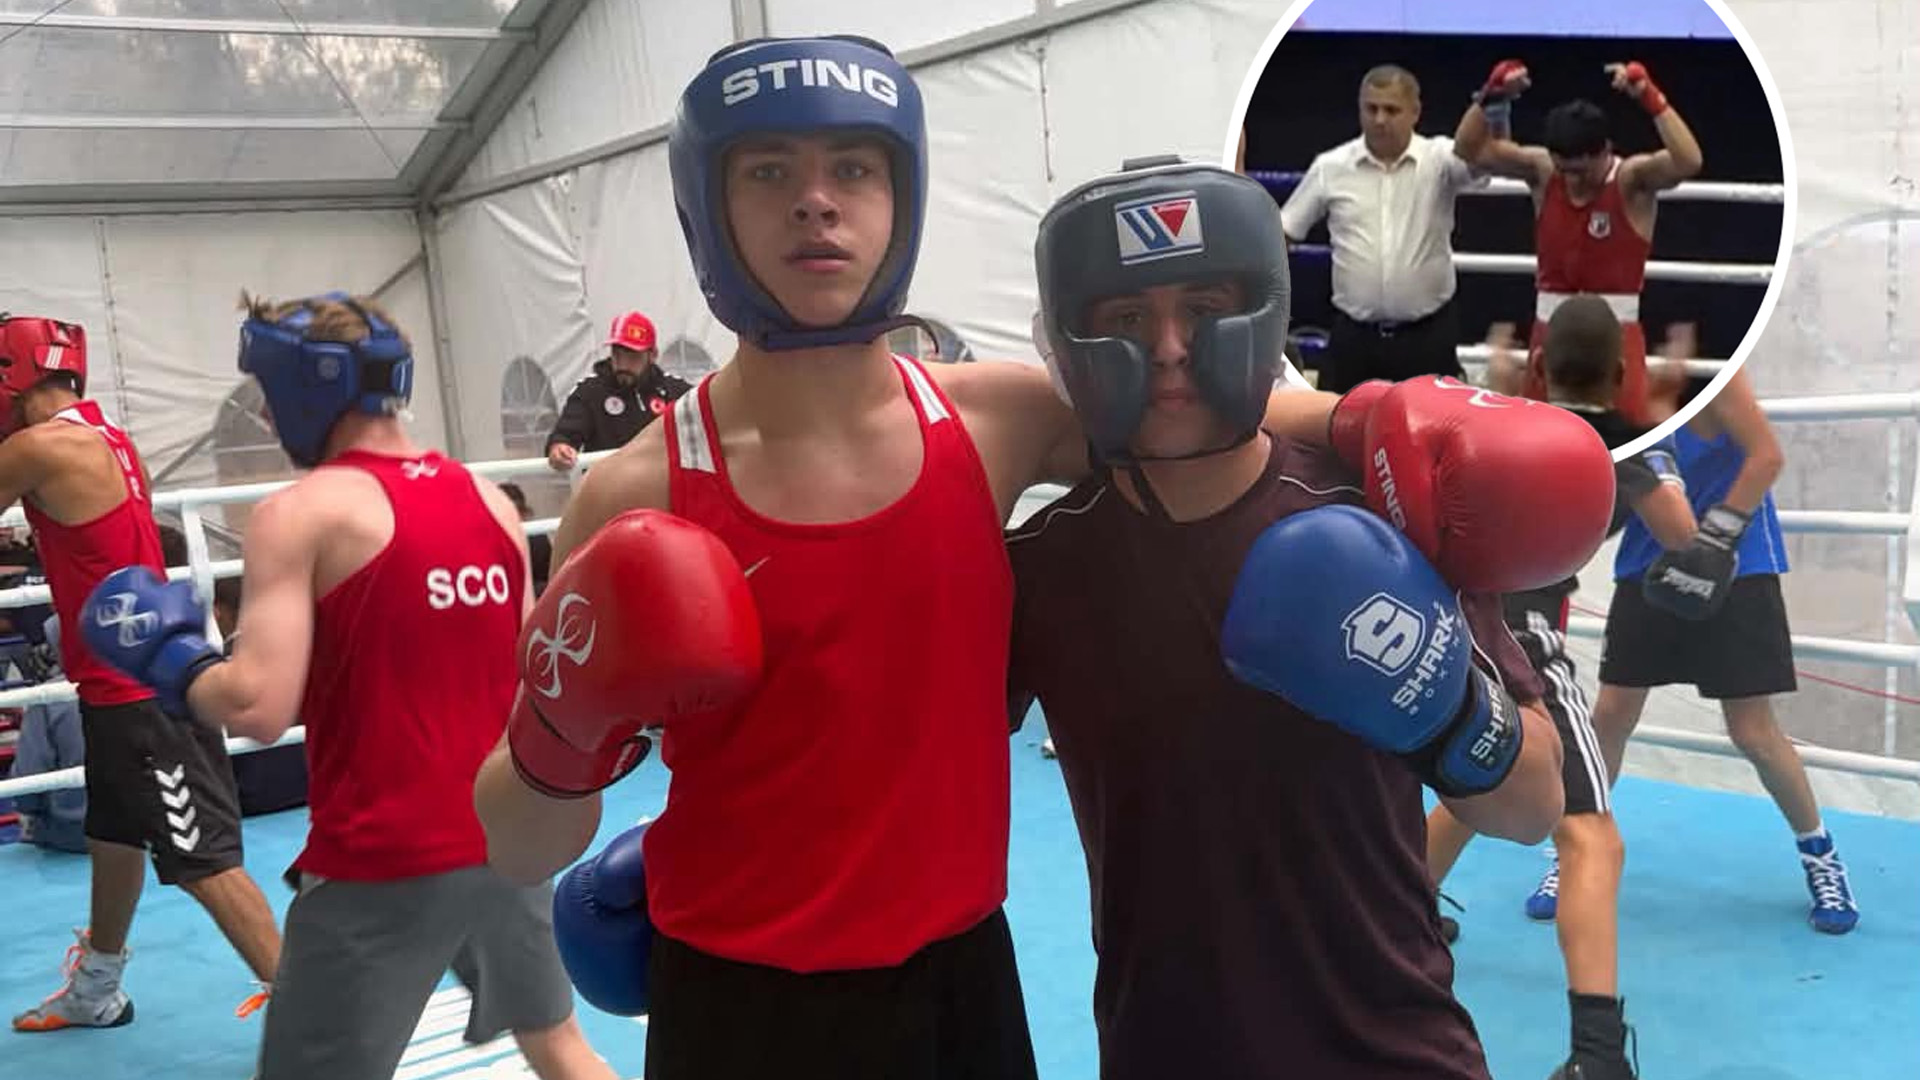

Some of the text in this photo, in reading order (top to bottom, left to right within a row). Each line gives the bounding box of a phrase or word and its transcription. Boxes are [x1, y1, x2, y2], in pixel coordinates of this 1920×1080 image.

[722, 59, 899, 108] STING
[1374, 447, 1407, 530] STING
[427, 564, 509, 610] SCO
[1391, 603, 1455, 709] SHARK
